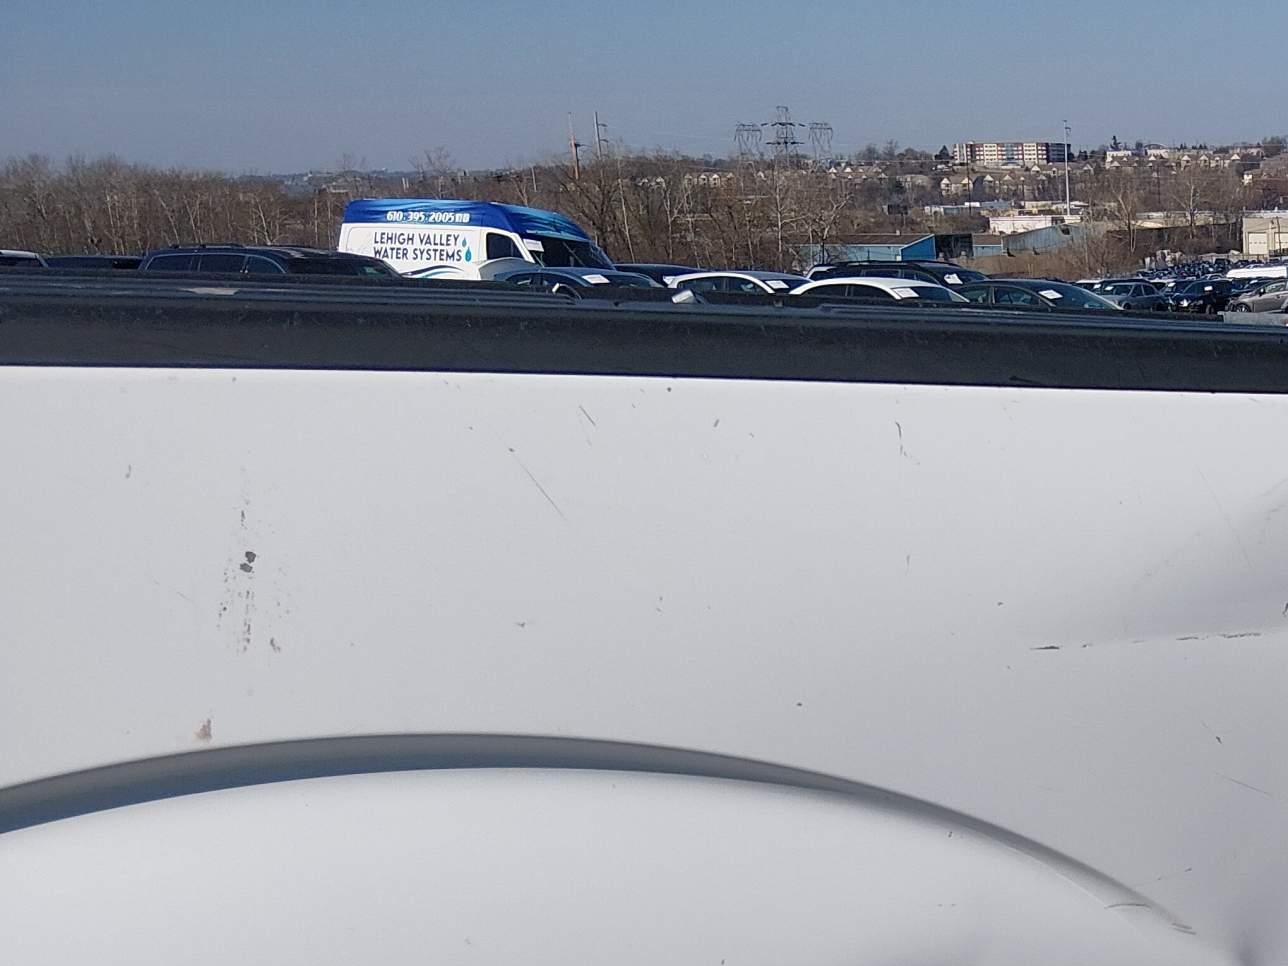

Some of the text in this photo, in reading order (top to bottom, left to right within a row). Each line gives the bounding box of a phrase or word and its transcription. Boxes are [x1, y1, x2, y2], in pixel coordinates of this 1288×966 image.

[374, 231, 460, 247] LEHIGH VALLEY
[373, 246, 462, 262] WATER SYSTEMS
